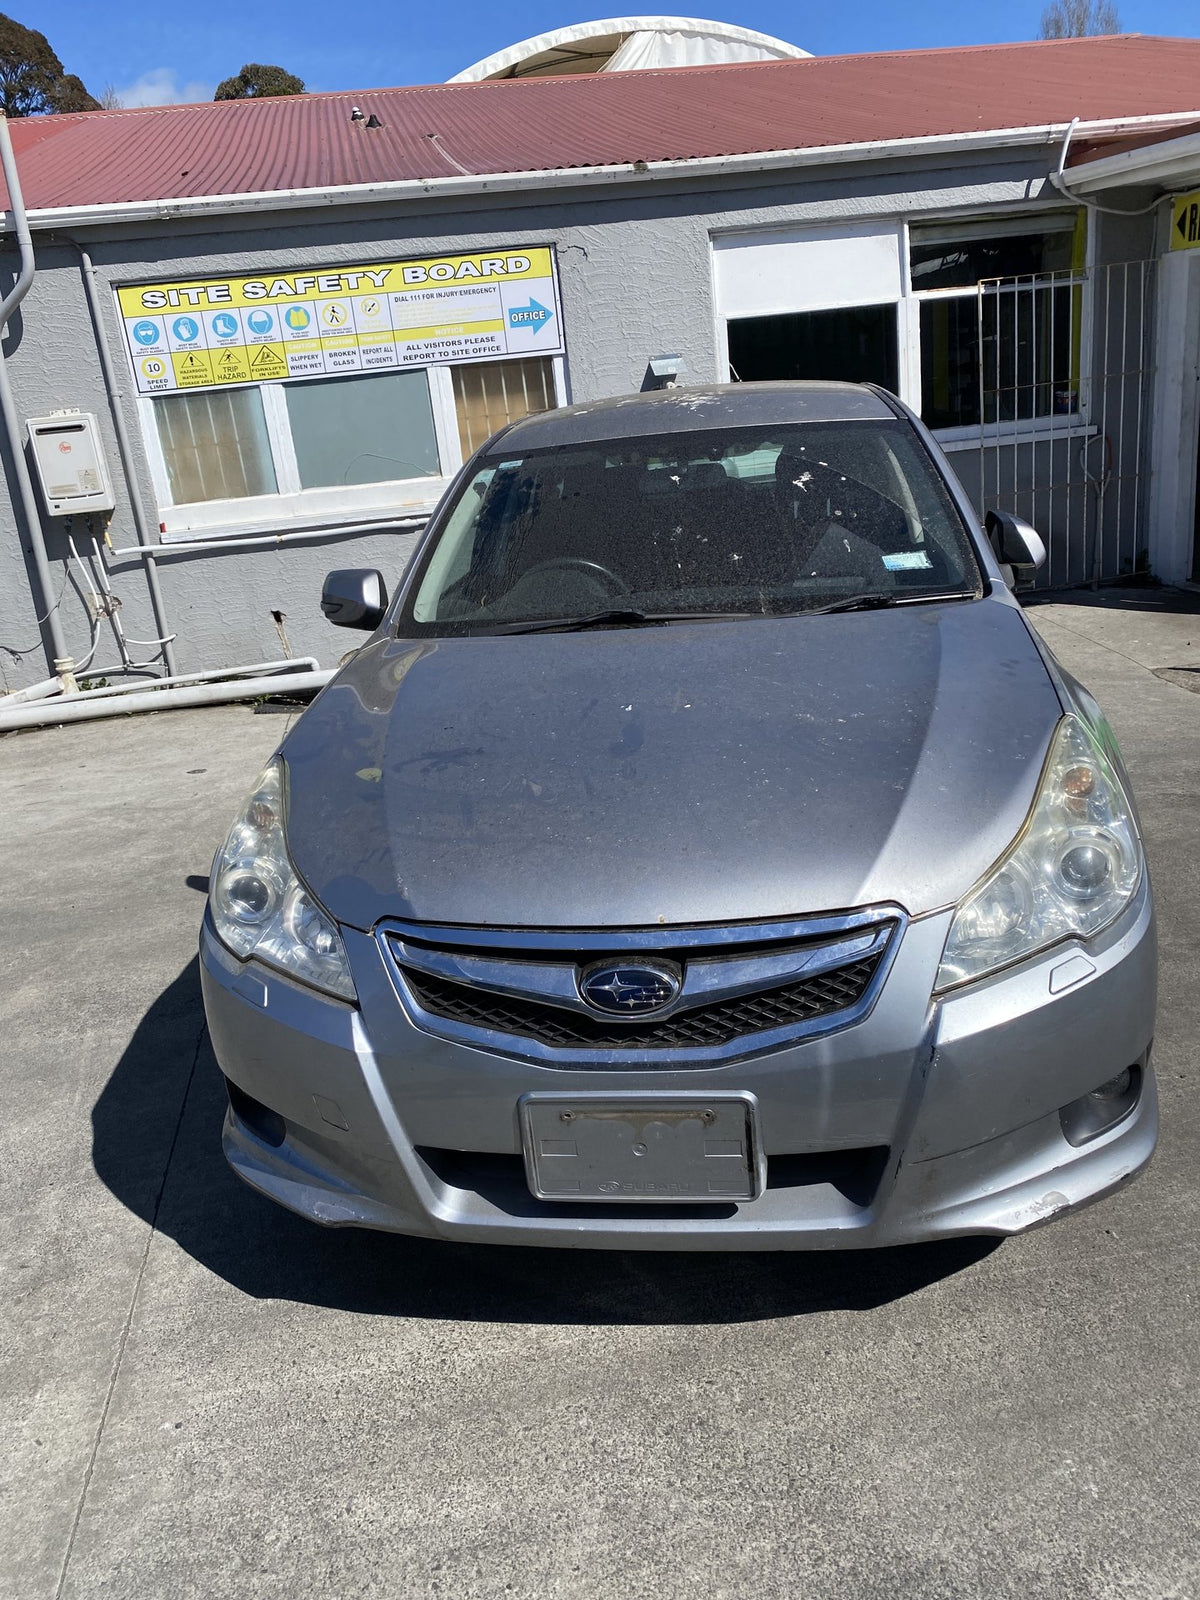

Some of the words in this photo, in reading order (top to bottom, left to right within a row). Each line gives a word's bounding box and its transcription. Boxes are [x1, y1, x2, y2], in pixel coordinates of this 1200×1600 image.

[1188, 203, 1200, 242] R
[142, 284, 232, 309] SITE
[242, 269, 392, 300] SAFETY
[402, 256, 531, 284] BOARD
[511, 310, 546, 322] OFFICE
[424, 338, 462, 349] VISITORS
[464, 336, 496, 344] PLEASE
[328, 350, 356, 358] BROKEN
[402, 352, 435, 361] REPORT
[472, 345, 501, 354] OFFICE
[366, 356, 393, 365] INCIDENTS
[148, 363, 160, 372] 10
[217, 372, 246, 380] HAZARD
